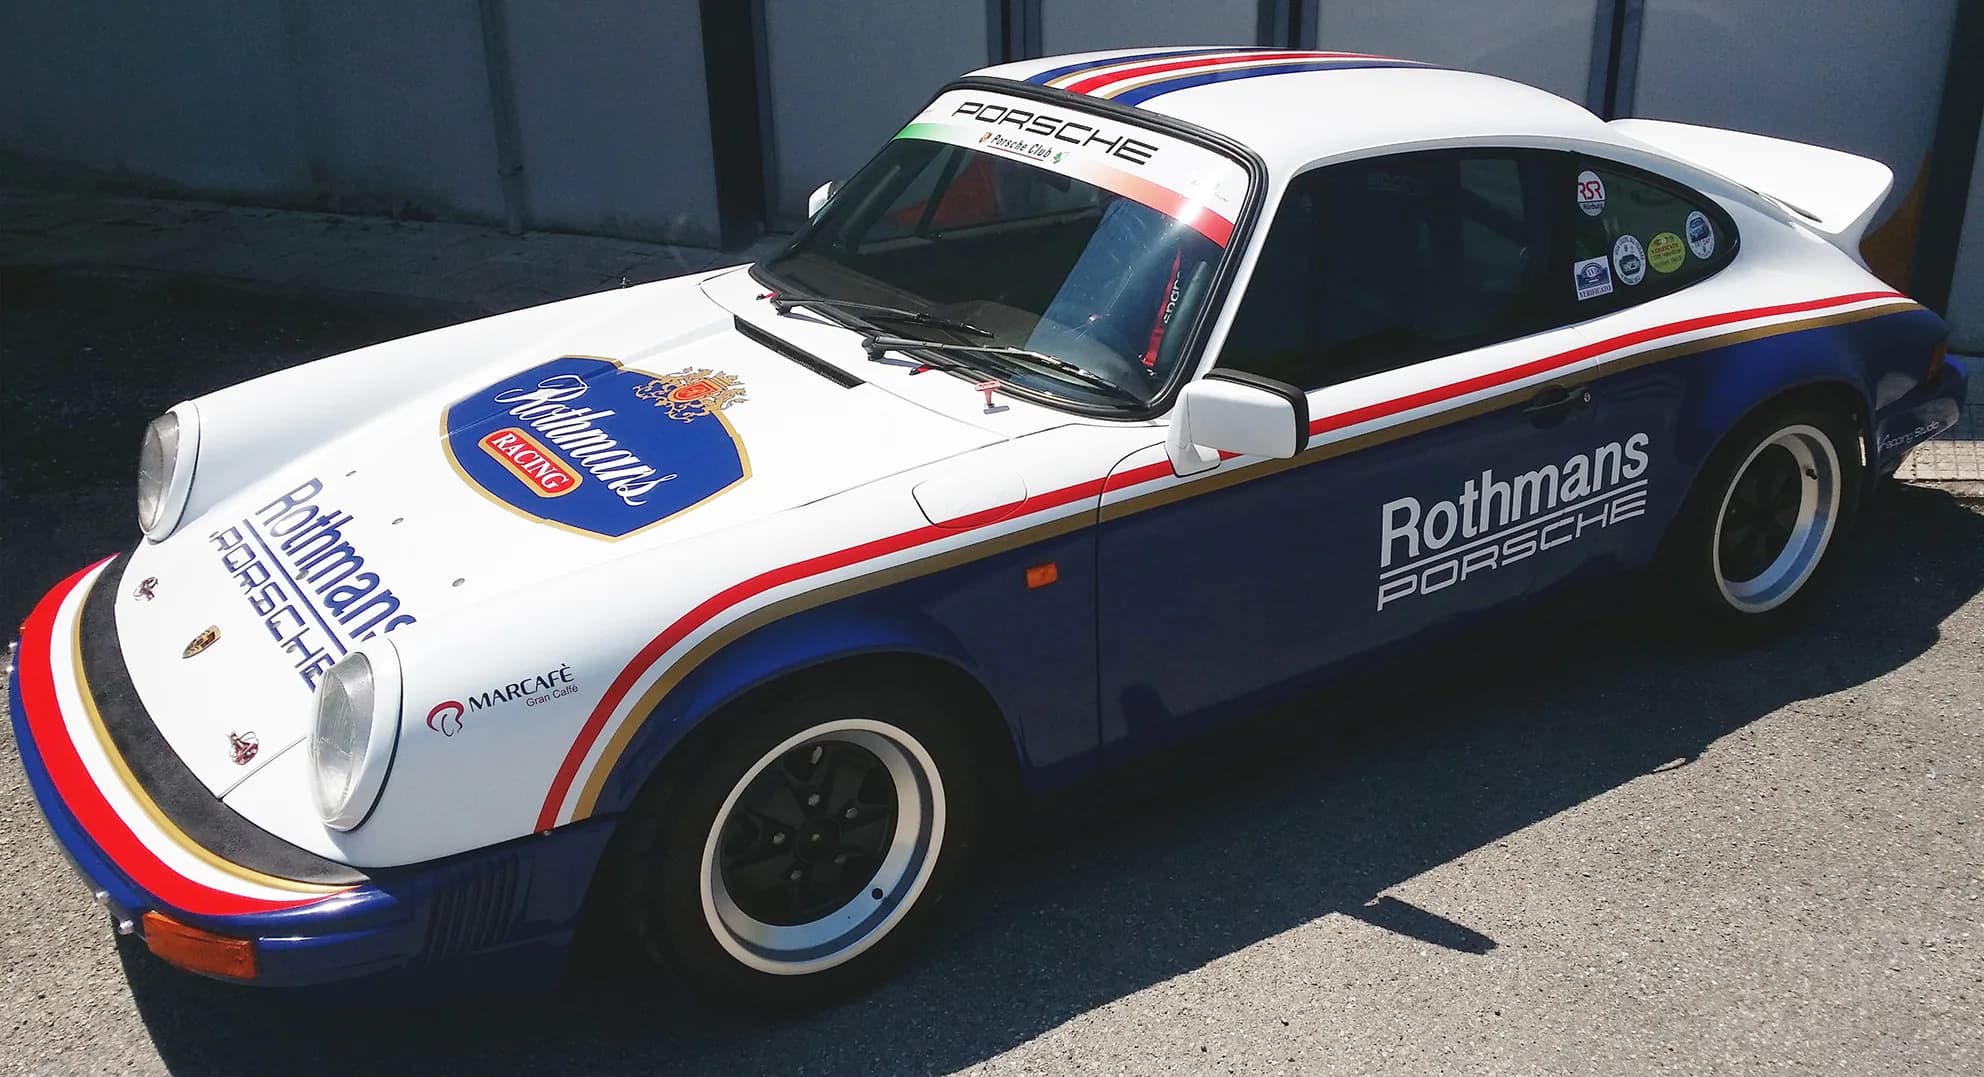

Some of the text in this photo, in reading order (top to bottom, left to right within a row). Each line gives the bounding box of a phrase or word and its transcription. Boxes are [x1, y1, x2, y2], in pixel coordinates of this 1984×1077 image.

[951, 101, 1159, 166] PORSCHE
[990, 134, 1053, 158] Porsche Club
[1578, 180, 1603, 201] RSR
[490, 432, 569, 489] RACING
[494, 374, 678, 507] Rothmans
[1380, 432, 1649, 568] Rothmans
[1377, 490, 1648, 611] PORSCHE
[468, 663, 575, 712] MARCAFÈ
[526, 693, 551, 708] Gran
